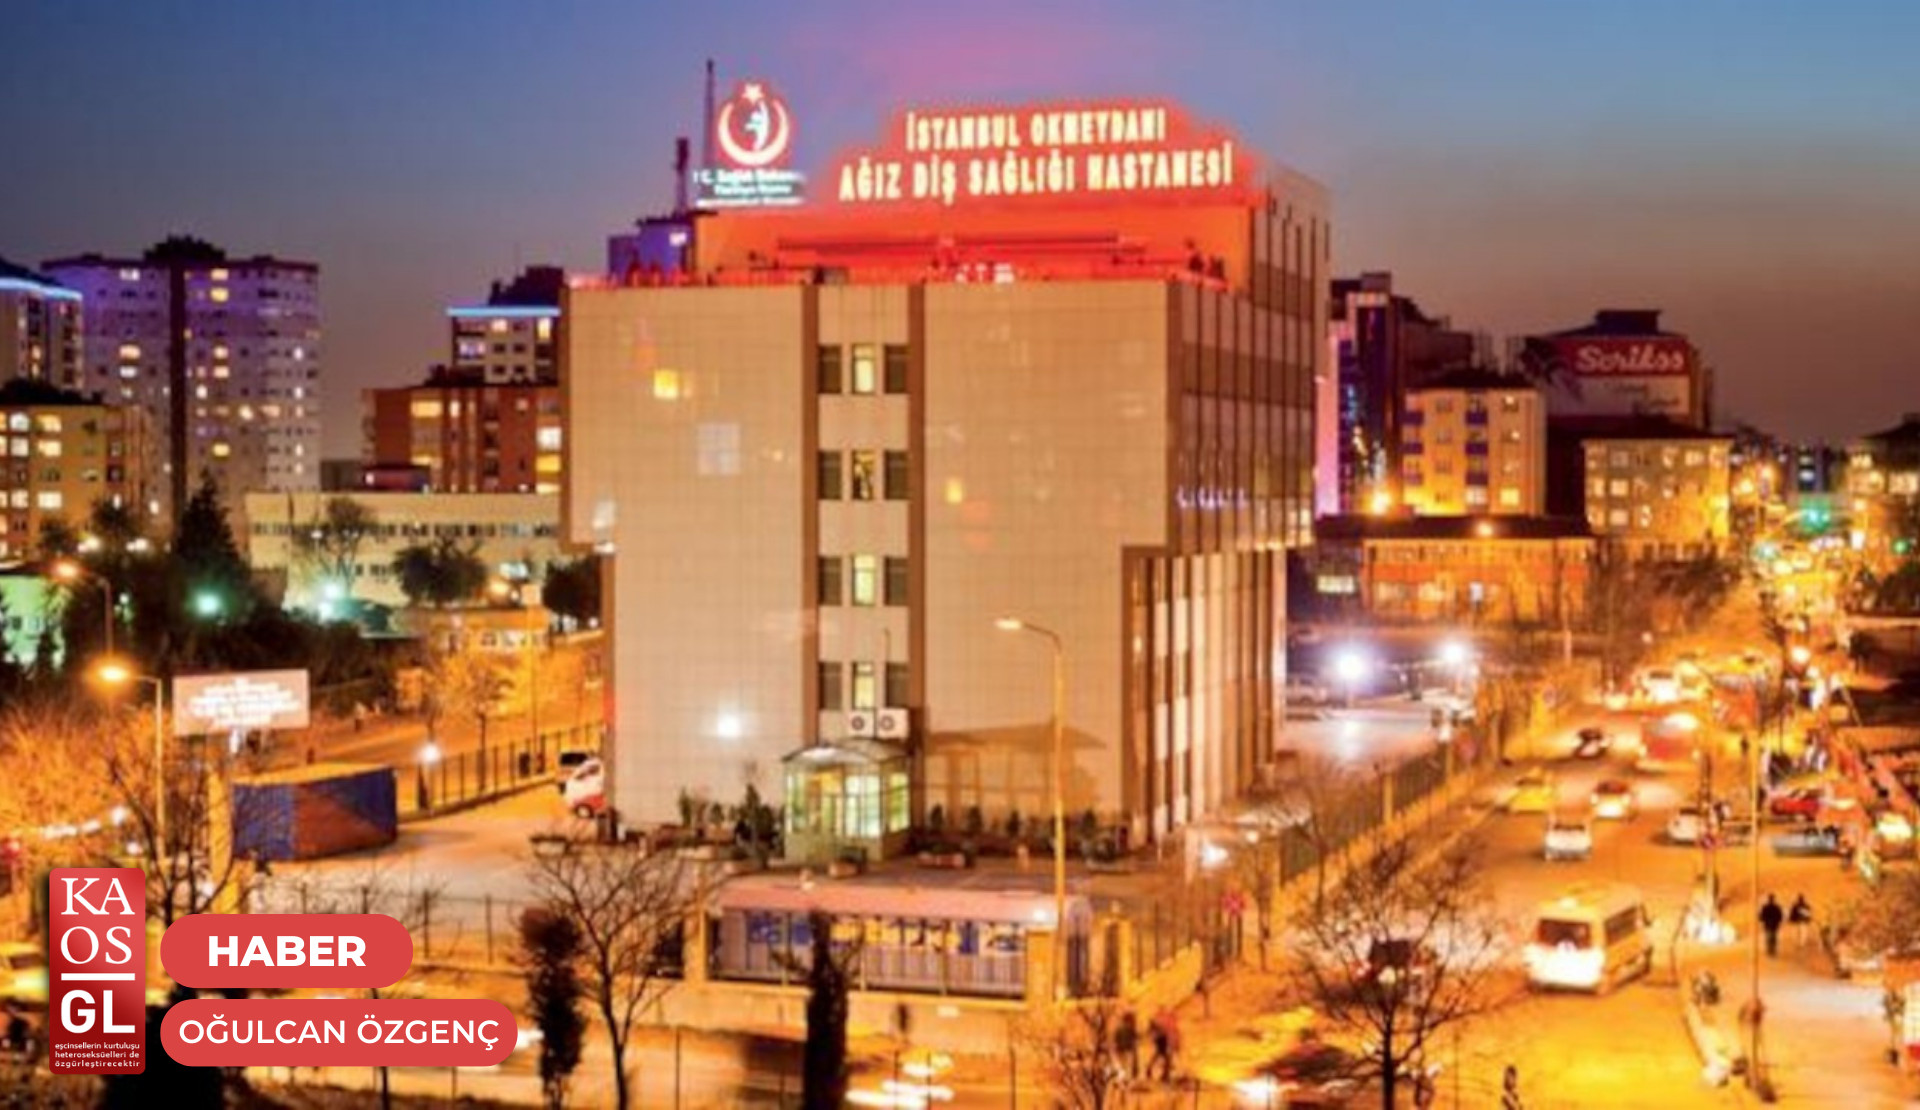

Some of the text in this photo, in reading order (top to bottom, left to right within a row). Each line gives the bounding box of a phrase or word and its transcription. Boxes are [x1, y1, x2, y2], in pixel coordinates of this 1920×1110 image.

[906, 108, 1166, 151] İSTANBUL OKMEYDANI
[839, 140, 1232, 206] AĞIZ DİŞ SAĞLIĞI HASTANESİ
